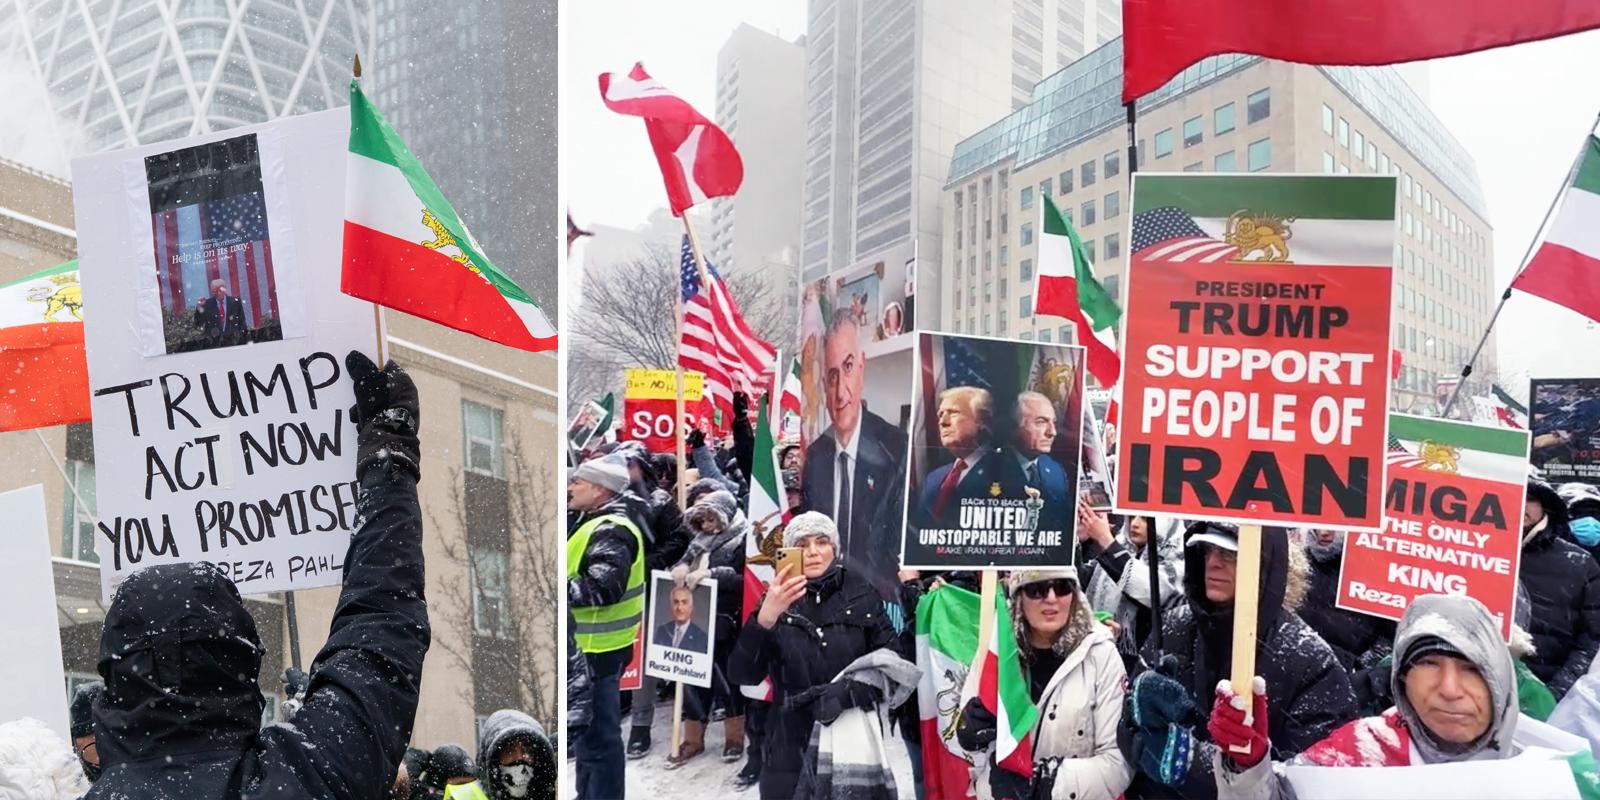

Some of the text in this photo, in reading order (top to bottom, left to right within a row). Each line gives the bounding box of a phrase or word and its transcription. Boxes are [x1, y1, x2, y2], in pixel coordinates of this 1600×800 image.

[172, 252, 191, 265] Help
[194, 251, 201, 260] is
[203, 249, 215, 258] on
[1195, 280, 1326, 300] PRESIDENT
[1169, 301, 1349, 339] TRUMP
[1144, 344, 1374, 386] SUPPORT
[94, 351, 341, 437] TRUMP
[649, 380, 665, 389] NO
[631, 410, 696, 440] SOS
[1141, 387, 1366, 445] PEOPLE OF
[144, 409, 342, 500] ACT NOW
[1128, 443, 1369, 520] IRAN
[960, 497, 1025, 507] BACK TO BACK
[1384, 478, 1507, 531] MIGA
[959, 506, 1027, 530] UNITED
[1384, 516, 1491, 549] THE ONLY
[98, 513, 180, 571] YOU
[918, 529, 1062, 546] UNSTOPPABLE WE ARE
[936, 546, 1045, 555] MAKE IRAN GREAT AGAIN
[1355, 533, 1511, 575] ALTERNATIVE
[1348, 581, 1406, 609] Reza
[1387, 562, 1468, 597] KING
[649, 660, 671, 672] Reza
[664, 650, 693, 665] KING
